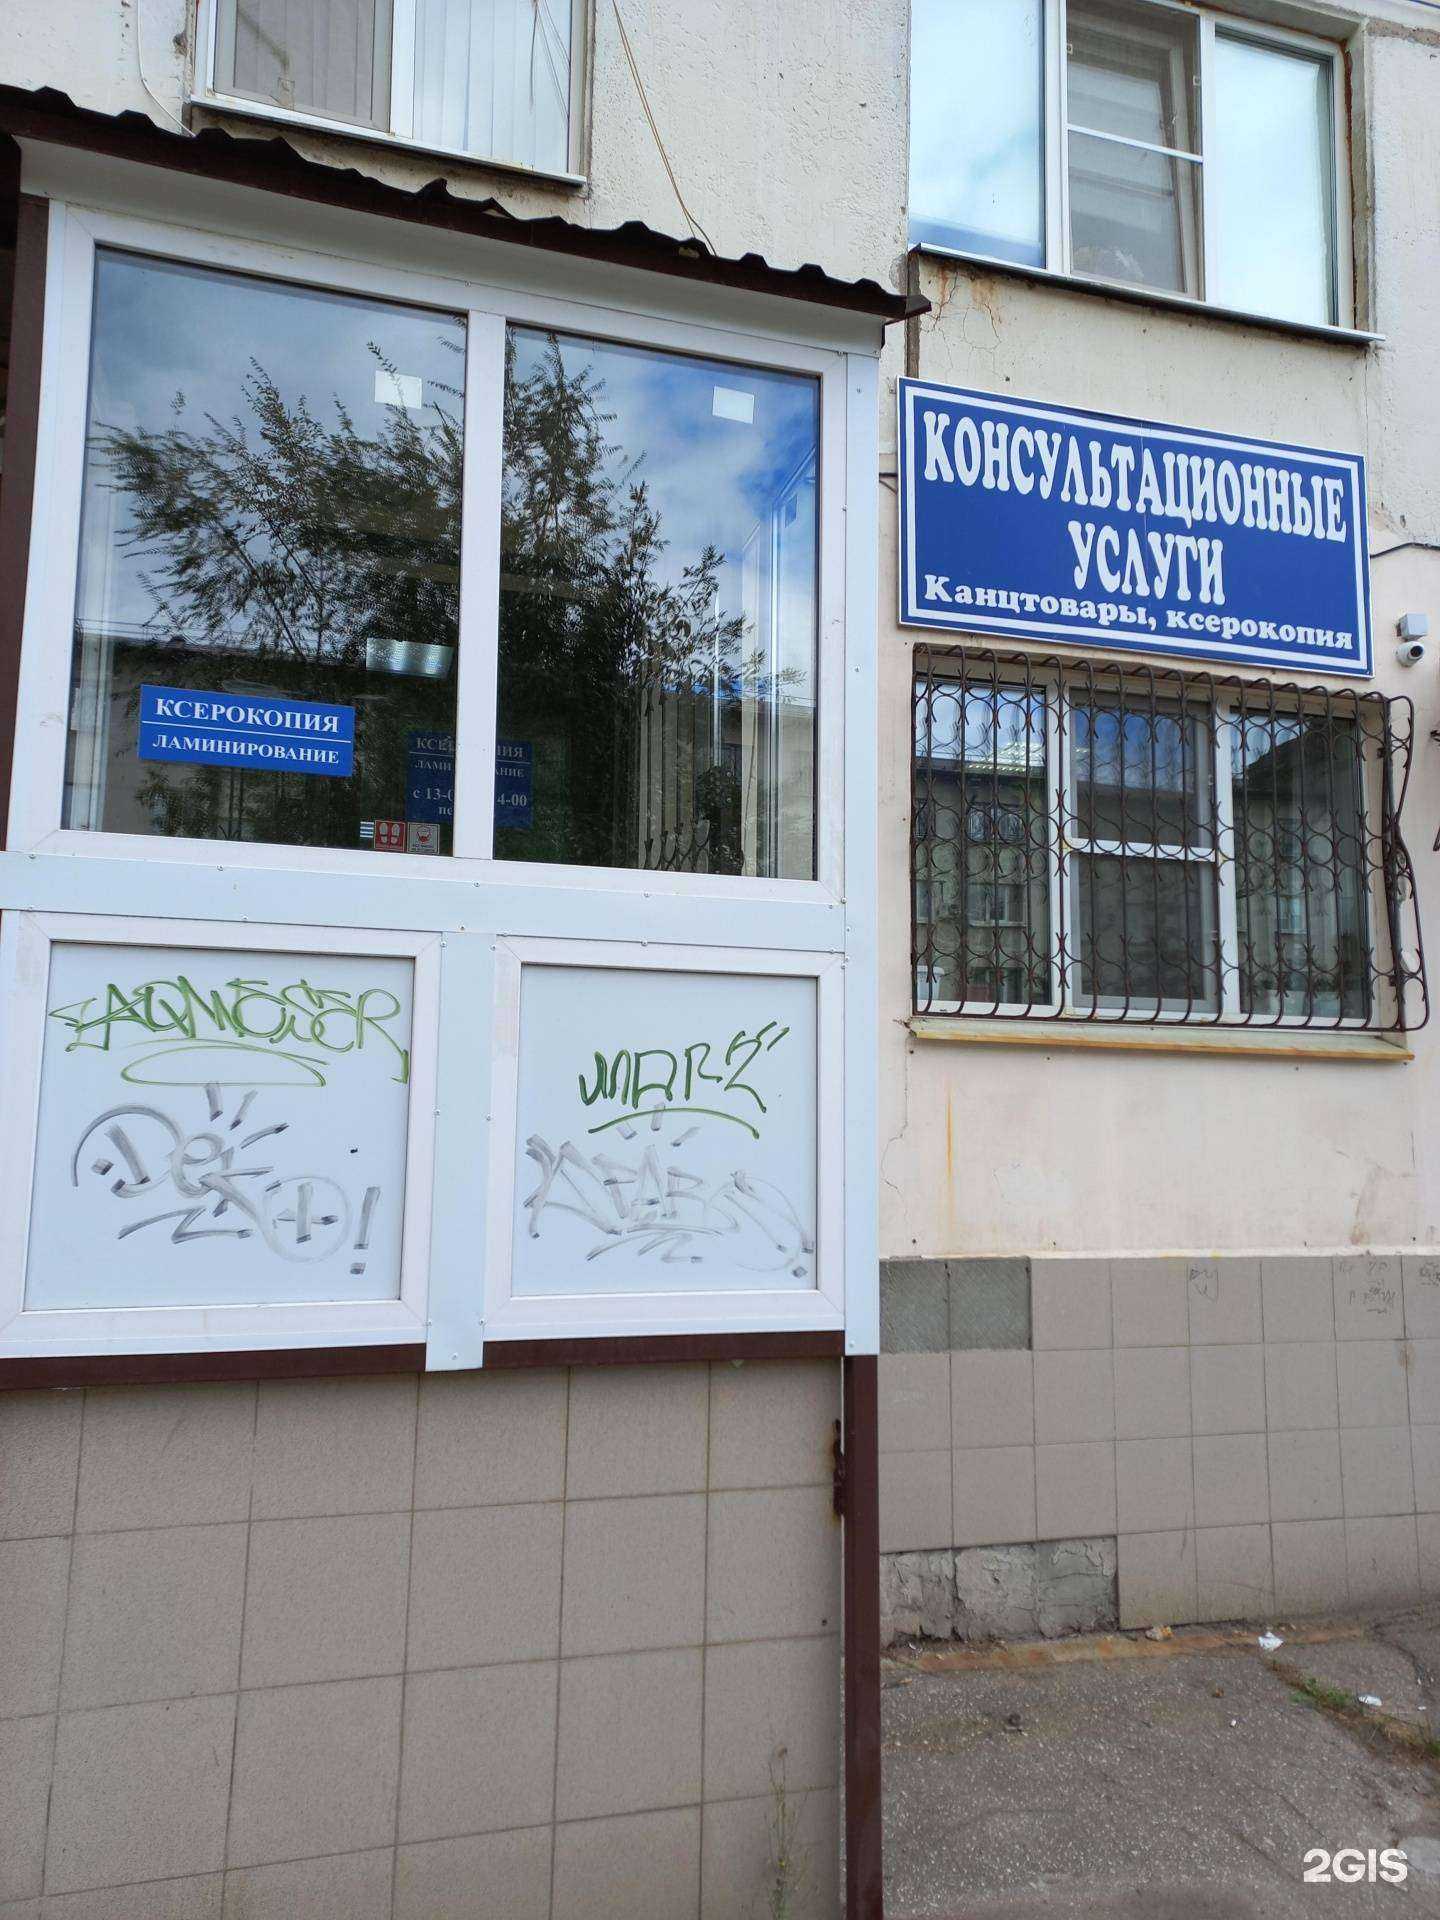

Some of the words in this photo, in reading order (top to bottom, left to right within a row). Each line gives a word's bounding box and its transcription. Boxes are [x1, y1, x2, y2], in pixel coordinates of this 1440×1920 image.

[923, 410, 1347, 543] КОНСУЛЬТАЦИОННЫЕ
[1067, 520, 1226, 605] УСЛУГИ
[923, 574, 1156, 631] Канцтовары,
[1166, 608, 1353, 650] ксерокопия
[152, 734, 340, 765] ЛАМИНИРОВАНИЕ
[155, 697, 340, 733] КСЕРОКОПИЯ
